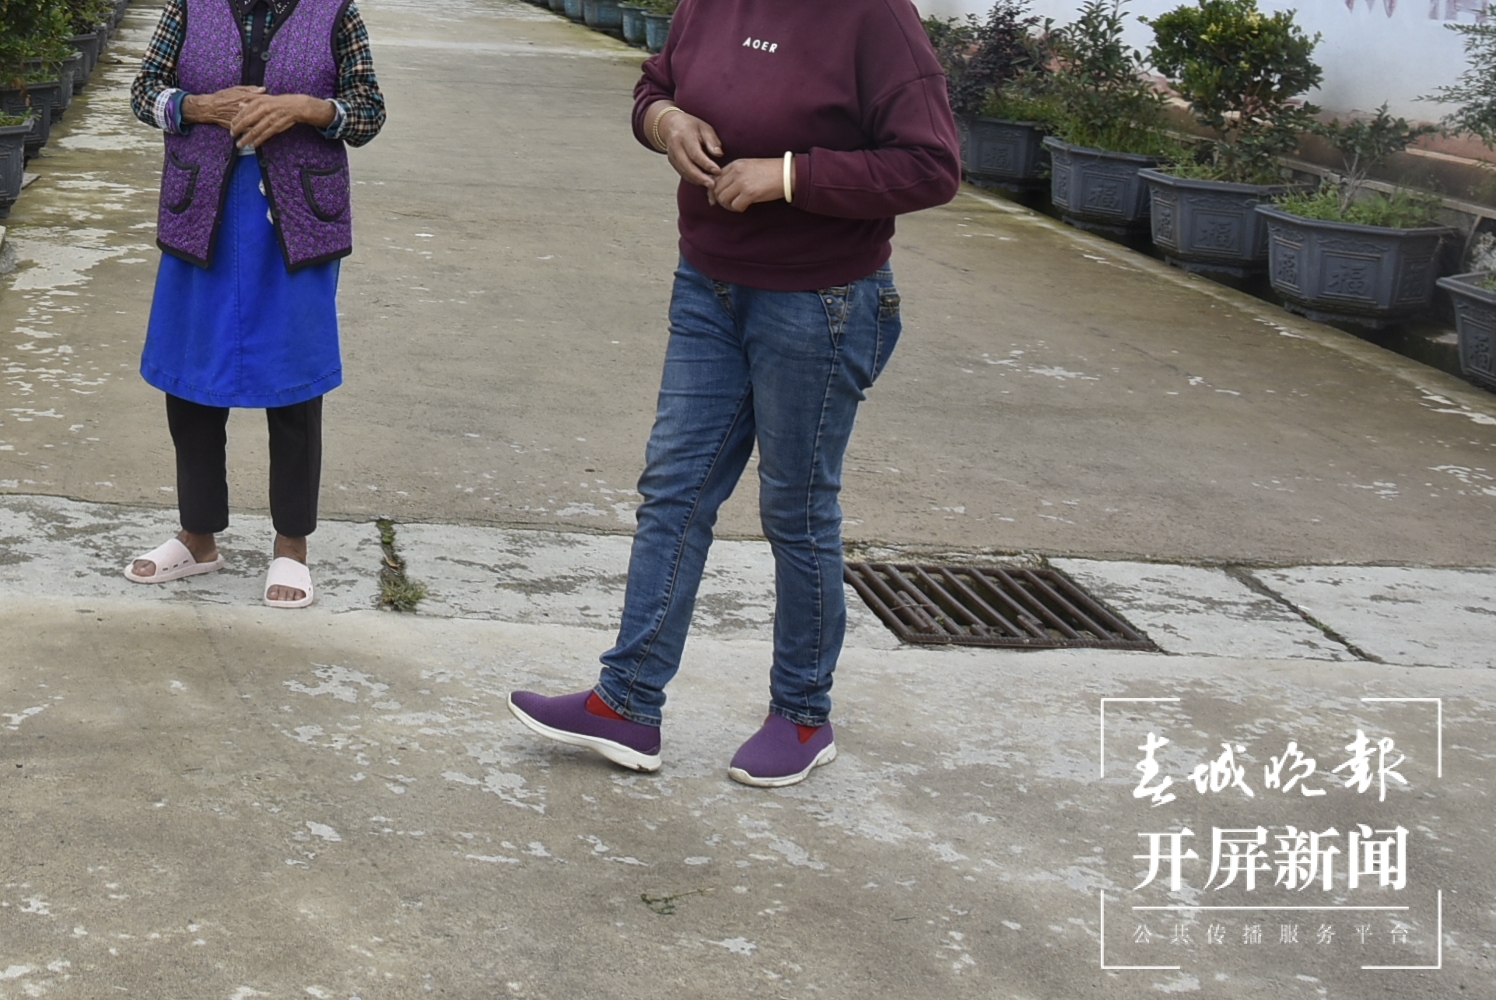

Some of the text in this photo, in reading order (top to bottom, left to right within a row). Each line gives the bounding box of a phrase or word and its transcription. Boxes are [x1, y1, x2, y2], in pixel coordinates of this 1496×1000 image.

[742, 36, 778, 53] AOER
[1086, 184, 1120, 210] 福
[1197, 217, 1236, 249] 福
[1277, 252, 1298, 285] 福
[1327, 263, 1368, 296] 福
[1469, 333, 1494, 372] 福
